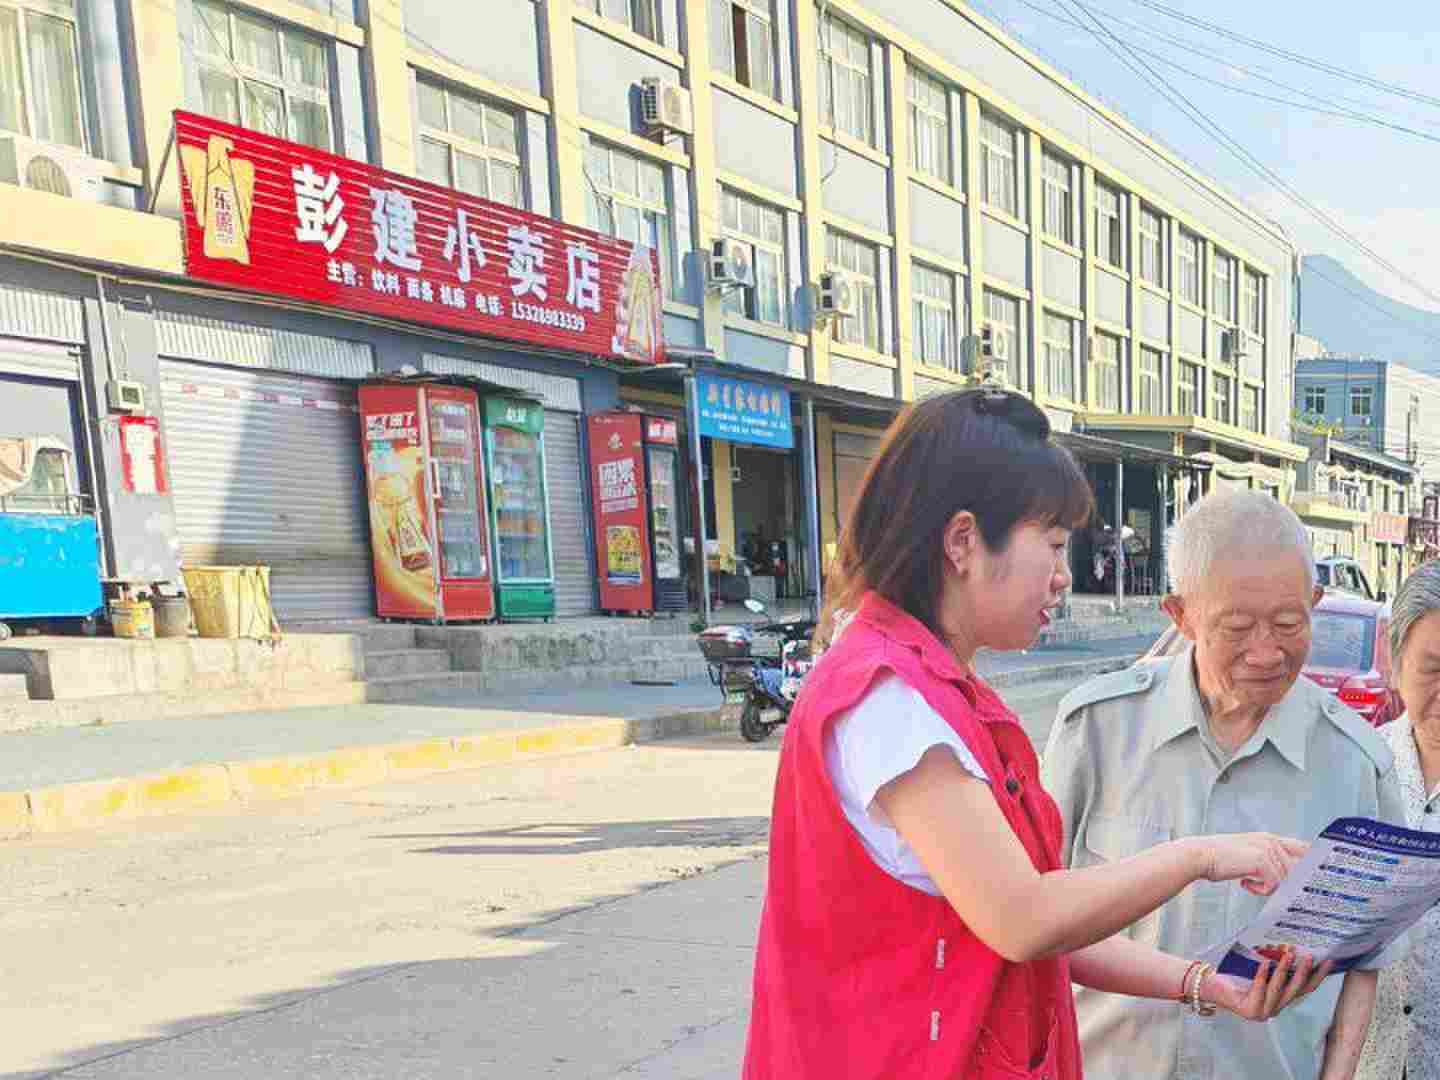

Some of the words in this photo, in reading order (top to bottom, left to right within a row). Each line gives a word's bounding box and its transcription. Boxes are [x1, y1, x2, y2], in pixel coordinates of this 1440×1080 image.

[291, 163, 601, 313] 彭建小卖店
